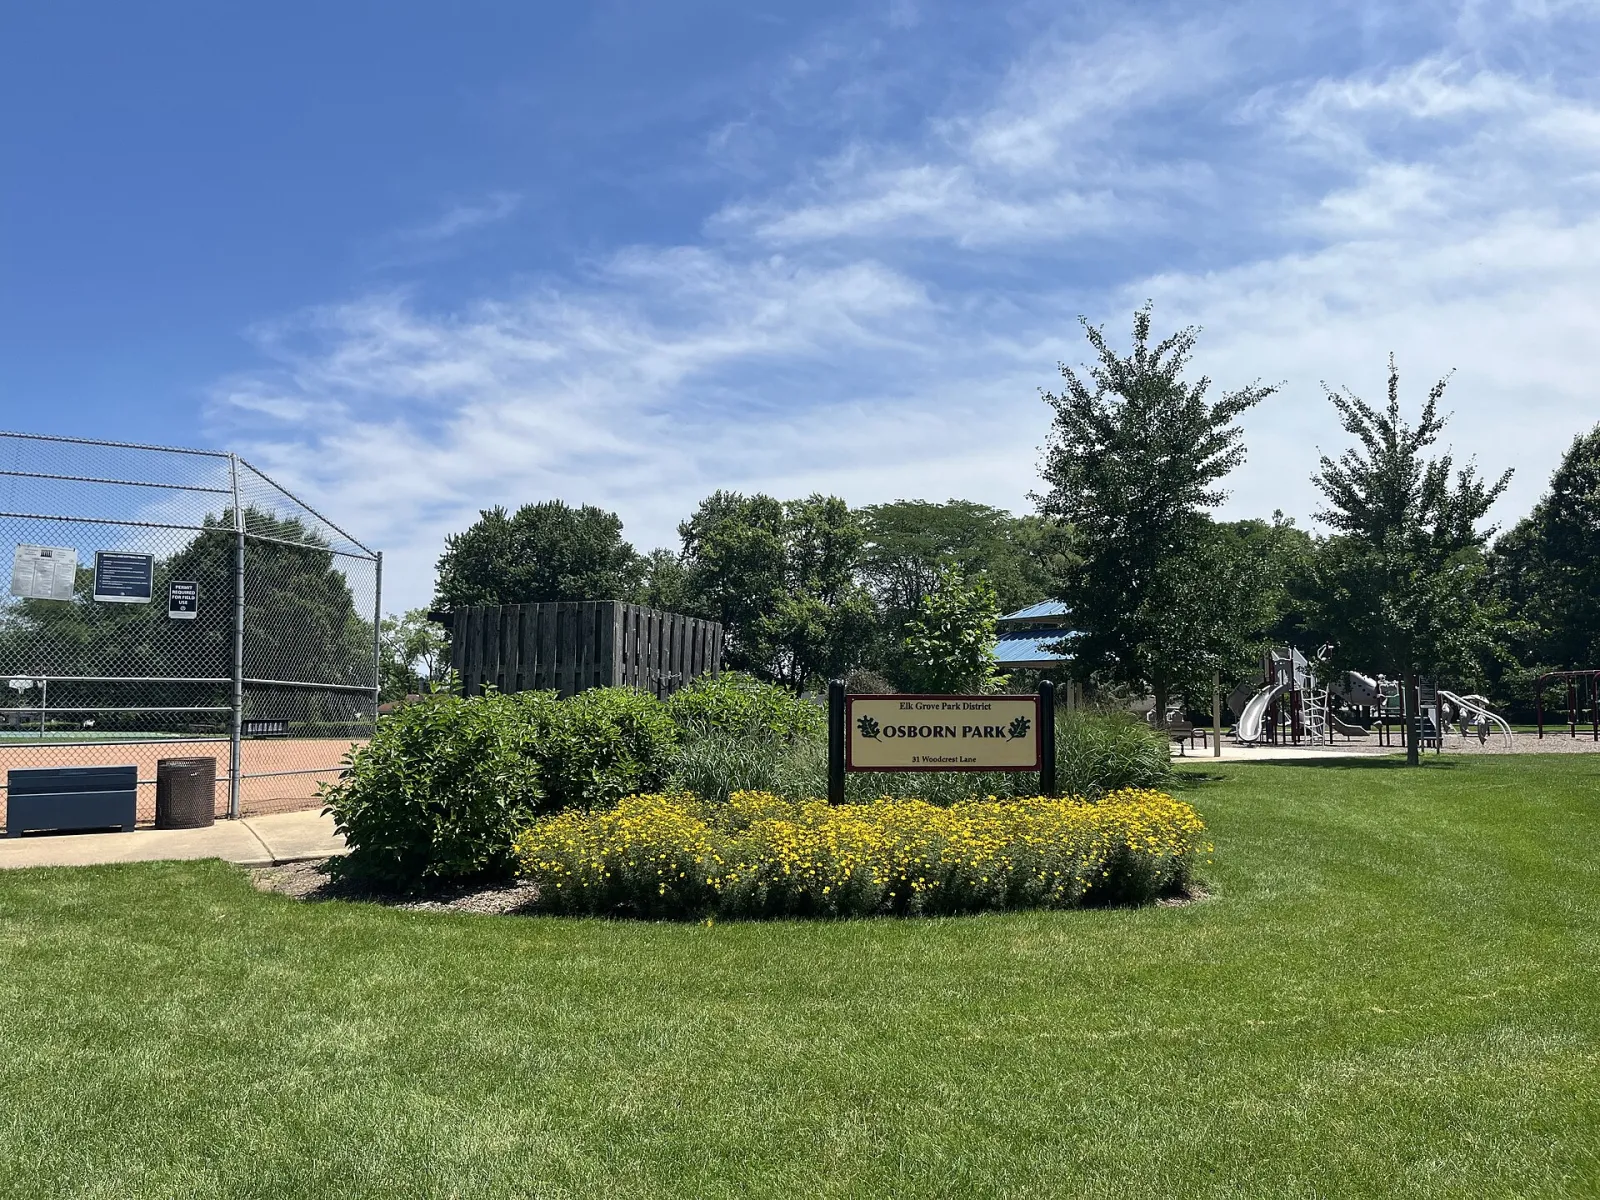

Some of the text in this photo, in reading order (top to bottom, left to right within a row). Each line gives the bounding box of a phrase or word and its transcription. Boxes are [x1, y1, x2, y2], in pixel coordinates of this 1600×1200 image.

[899, 702, 991, 711] Elk Grove Park District
[883, 725, 1006, 738] OSBORN PARK
